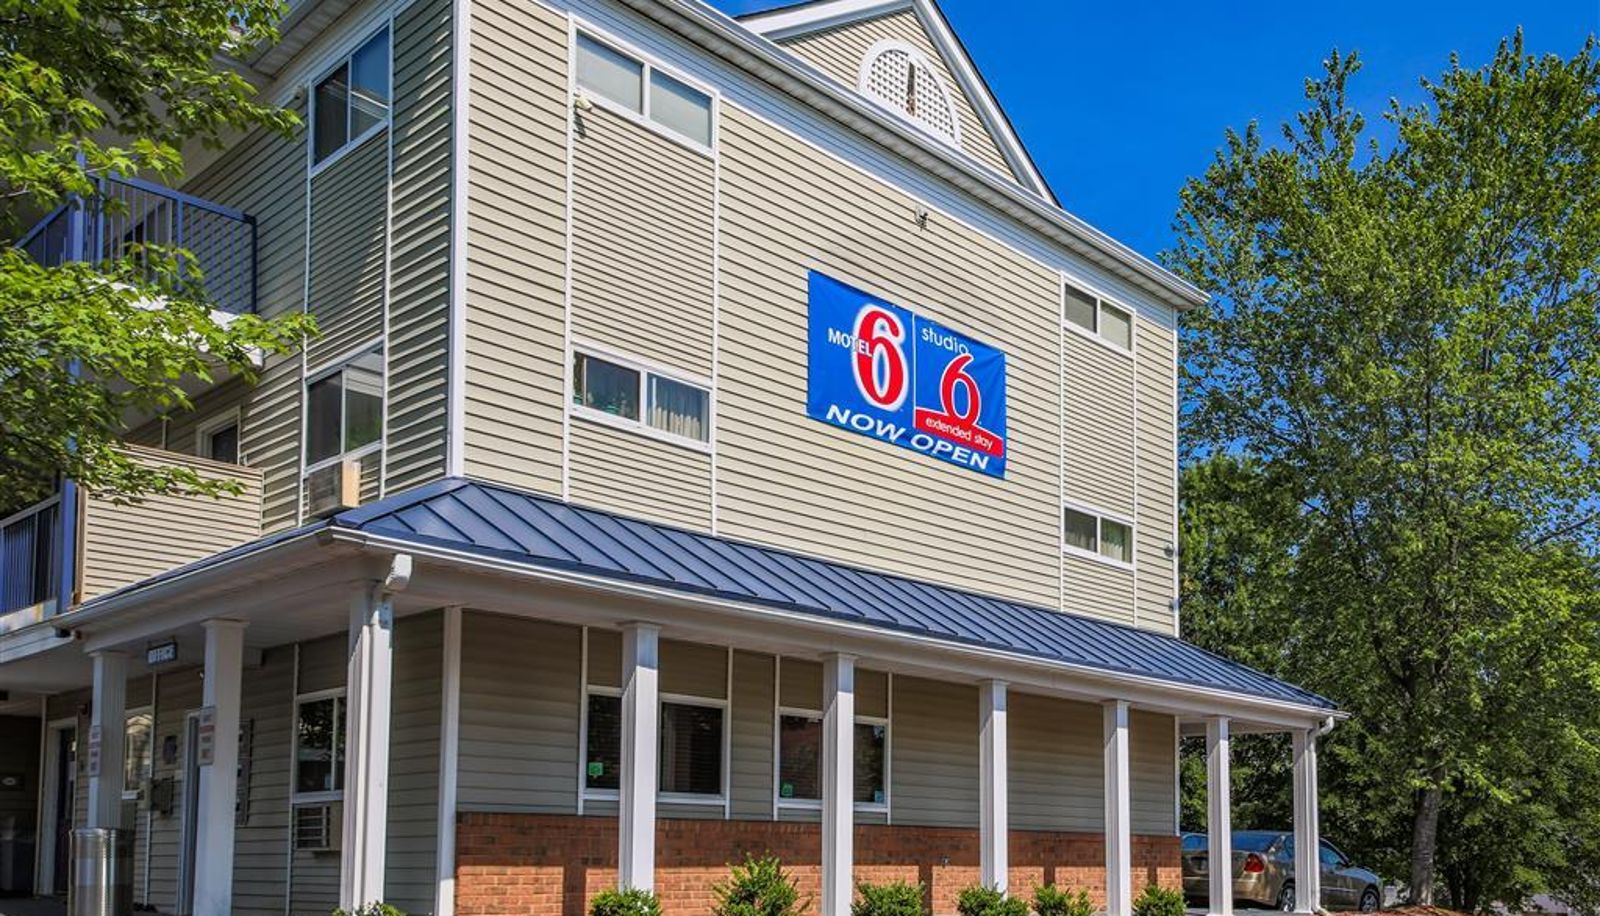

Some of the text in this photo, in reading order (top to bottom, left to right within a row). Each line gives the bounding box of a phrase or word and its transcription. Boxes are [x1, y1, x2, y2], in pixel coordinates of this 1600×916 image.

[828, 304, 909, 411] MOTEL 6
[922, 327, 969, 355] studio
[940, 353, 981, 425] 6
[826, 404, 990, 470] NOW OPEN
[925, 417, 994, 451] extended stay
